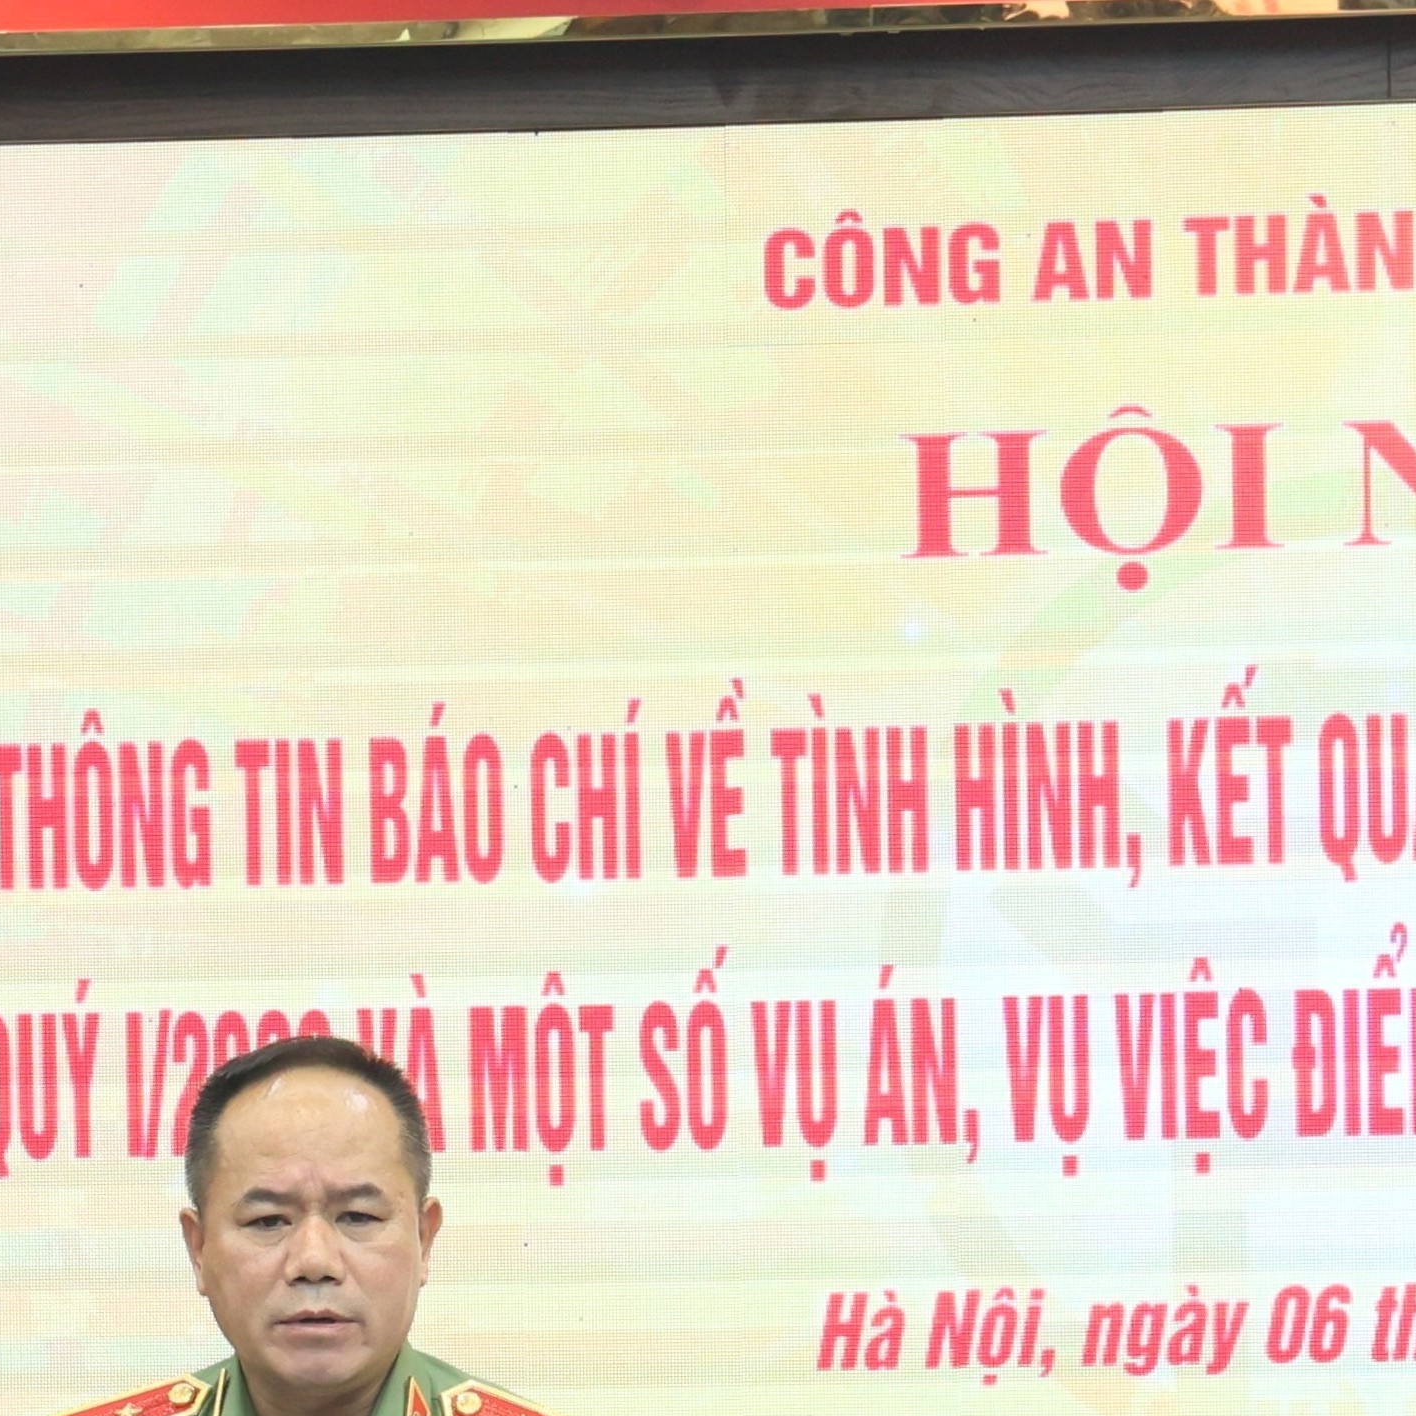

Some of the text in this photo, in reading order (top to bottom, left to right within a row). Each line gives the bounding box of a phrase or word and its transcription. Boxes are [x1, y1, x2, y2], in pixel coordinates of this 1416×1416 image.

[763, 208, 1002, 312] CÔNG
[1032, 217, 1154, 303] AN
[900, 404, 1285, 592] HỘI
[233, 737, 346, 888] TIN
[367, 701, 505, 886] BÁO
[529, 697, 643, 885] CHÍ
[664, 677, 749, 880] VỀ
[769, 693, 931, 876] TÌNH
[952, 688, 1143, 889] HÌNH,
[1166, 664, 1294, 868] KẾT
[125, 1006, 333, 1160] I/2
[467, 969, 616, 1189] MỘT
[638, 944, 729, 1153] SỐ
[750, 998, 839, 1183] VỤ
[862, 963, 981, 1163] ÁN,
[1003, 992, 1091, 1178] VỤ
[1114, 955, 1270, 1176] VIỆC
[816, 1289, 907, 1372] Hà
[924, 1285, 1057, 1387] Nội,
[1080, 1284, 1250, 1378] ngày
[1265, 1282, 1353, 1366] 06
